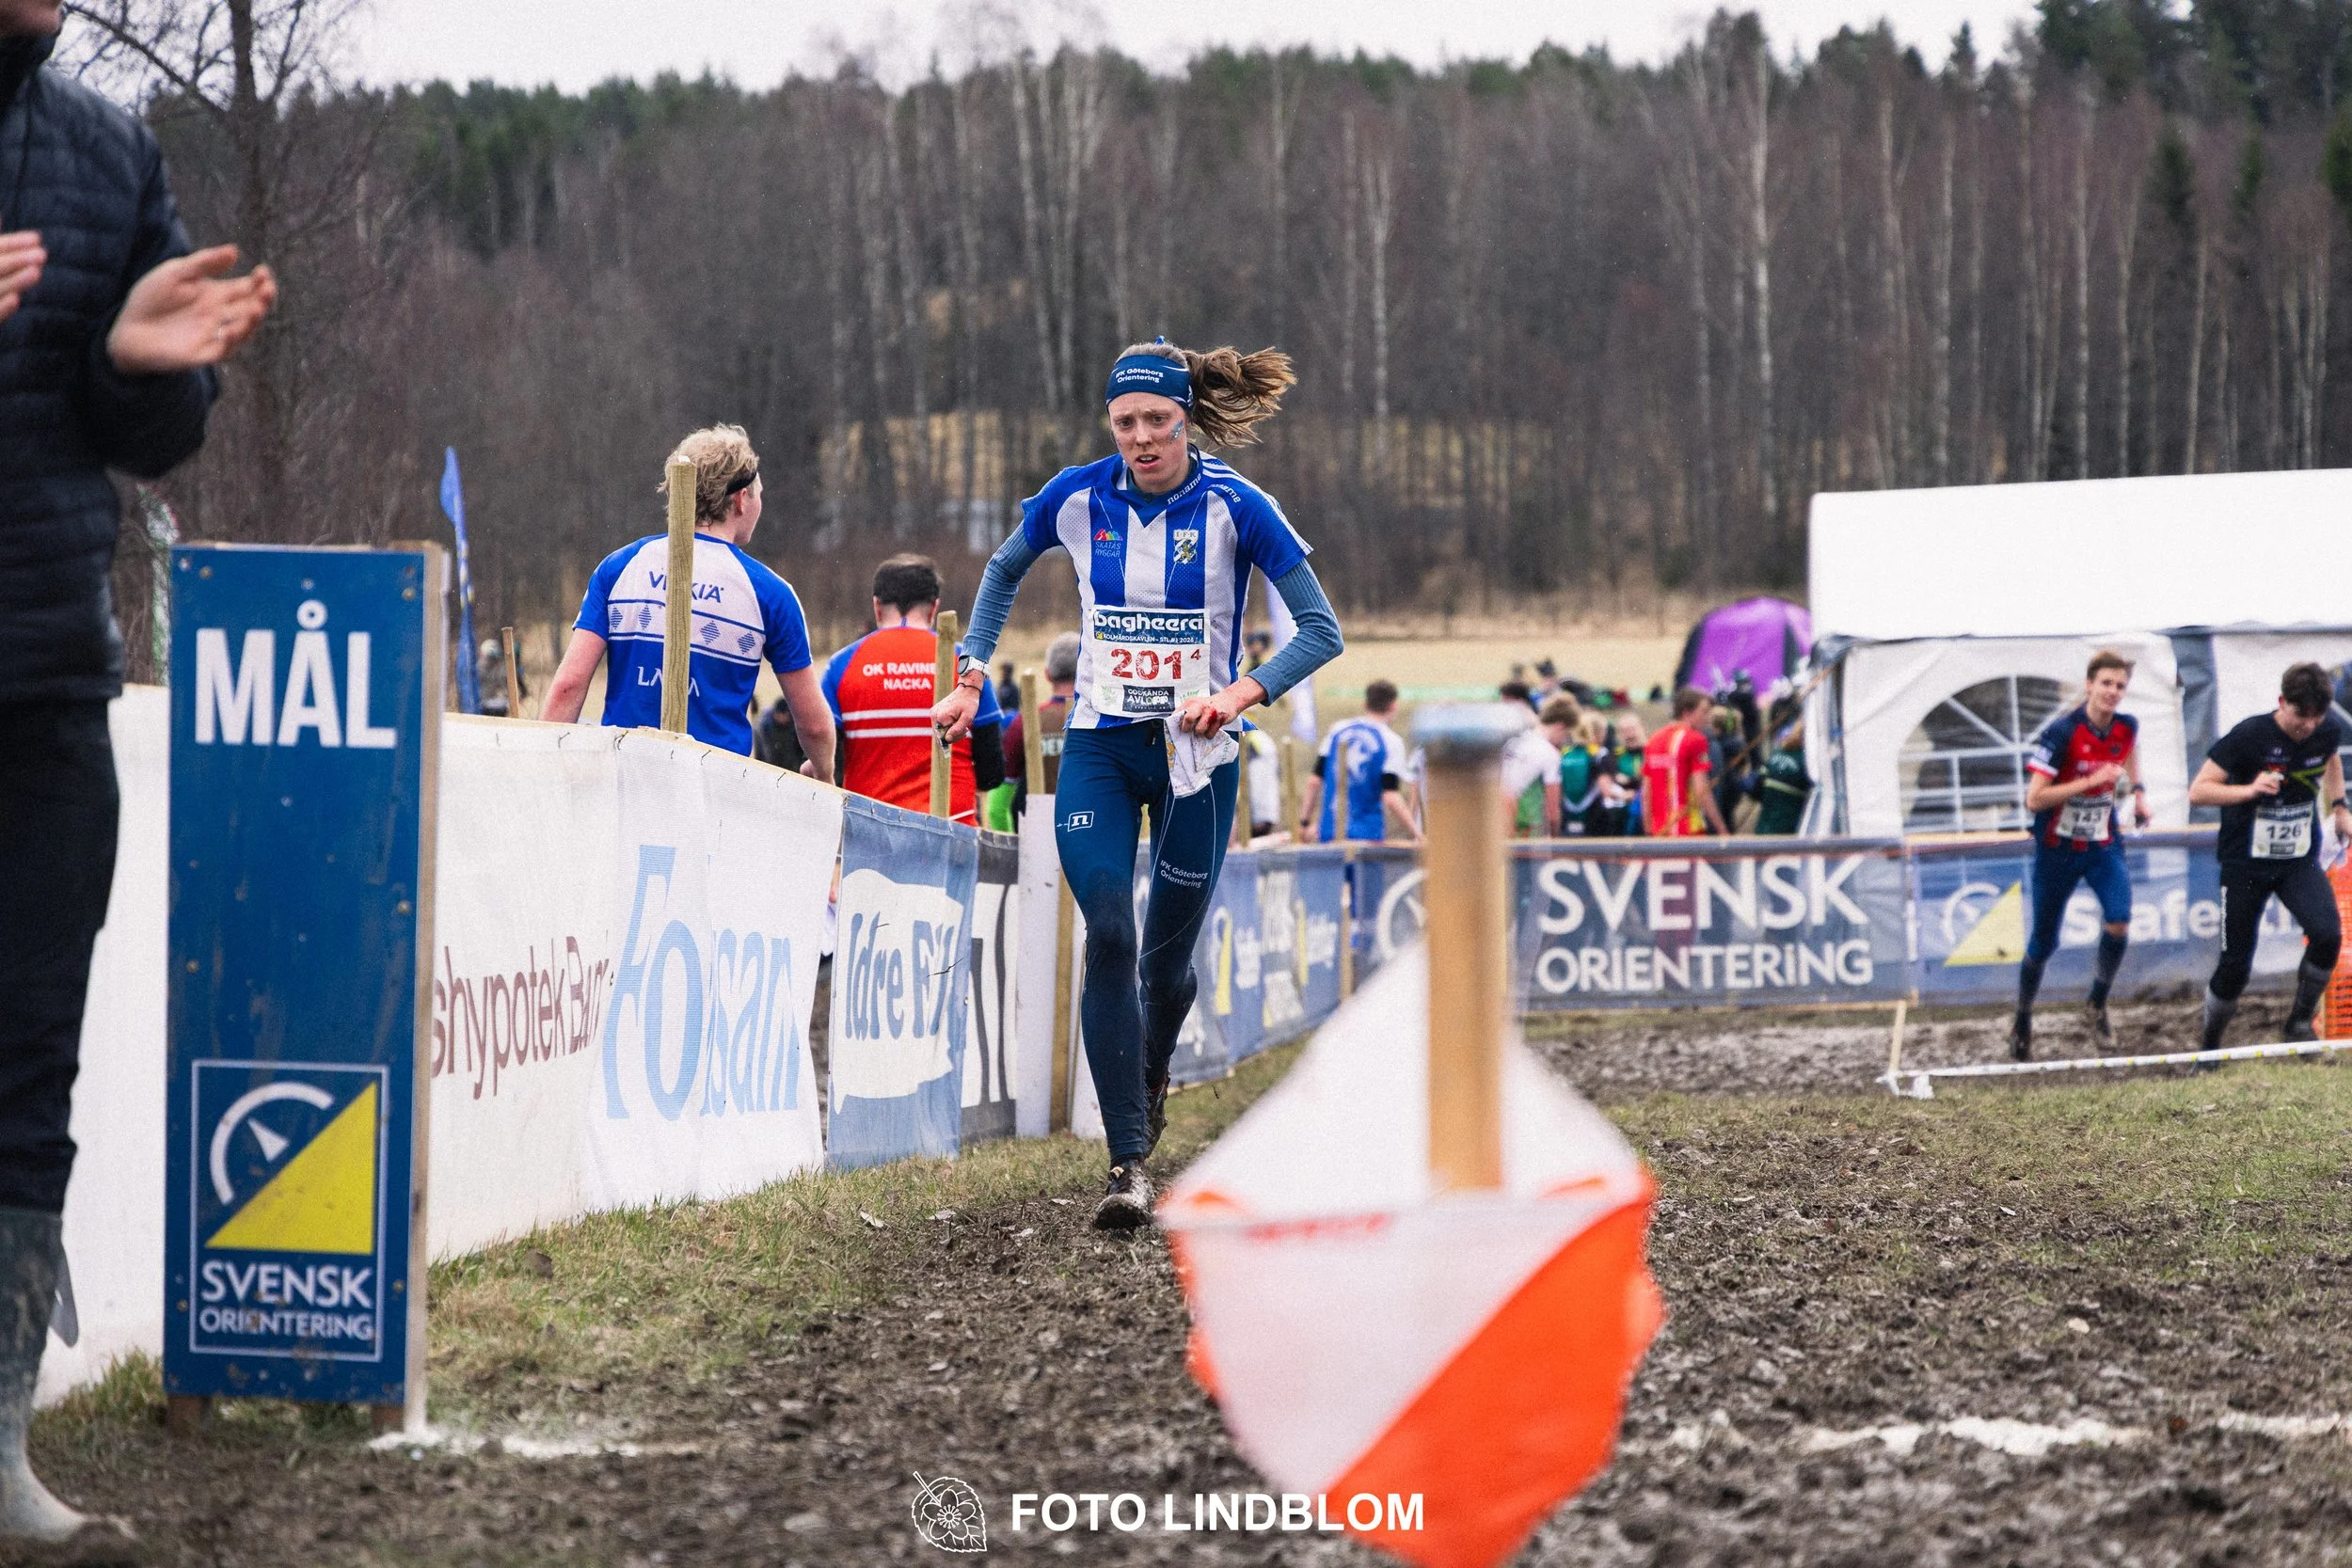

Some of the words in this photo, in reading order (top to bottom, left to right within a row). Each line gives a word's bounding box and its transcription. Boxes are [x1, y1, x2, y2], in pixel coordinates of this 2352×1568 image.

[649, 571, 724, 603] VIKIÄ
[1094, 611, 1203, 632] bagheera
[195, 599, 398, 750] MÅL
[863, 662, 884, 677] OK
[886, 661, 937, 675] RAVINE
[1110, 648, 1182, 681] 201
[1190, 649, 1201, 661] 4
[882, 677, 932, 690] NACKA
[2265, 824, 2301, 839] 126
[1160, 860, 1171, 871] IFK
[1172, 867, 1209, 879] Göteborg
[1160, 869, 1202, 888] Orientering
[1537, 854, 1869, 935] SVENSK
[846, 912, 905, 1041] Idre
[1535, 939, 1875, 993] ORIENTERING
[200, 1259, 373, 1308] SVENSK
[199, 1306, 373, 1341] ORIENTERING
